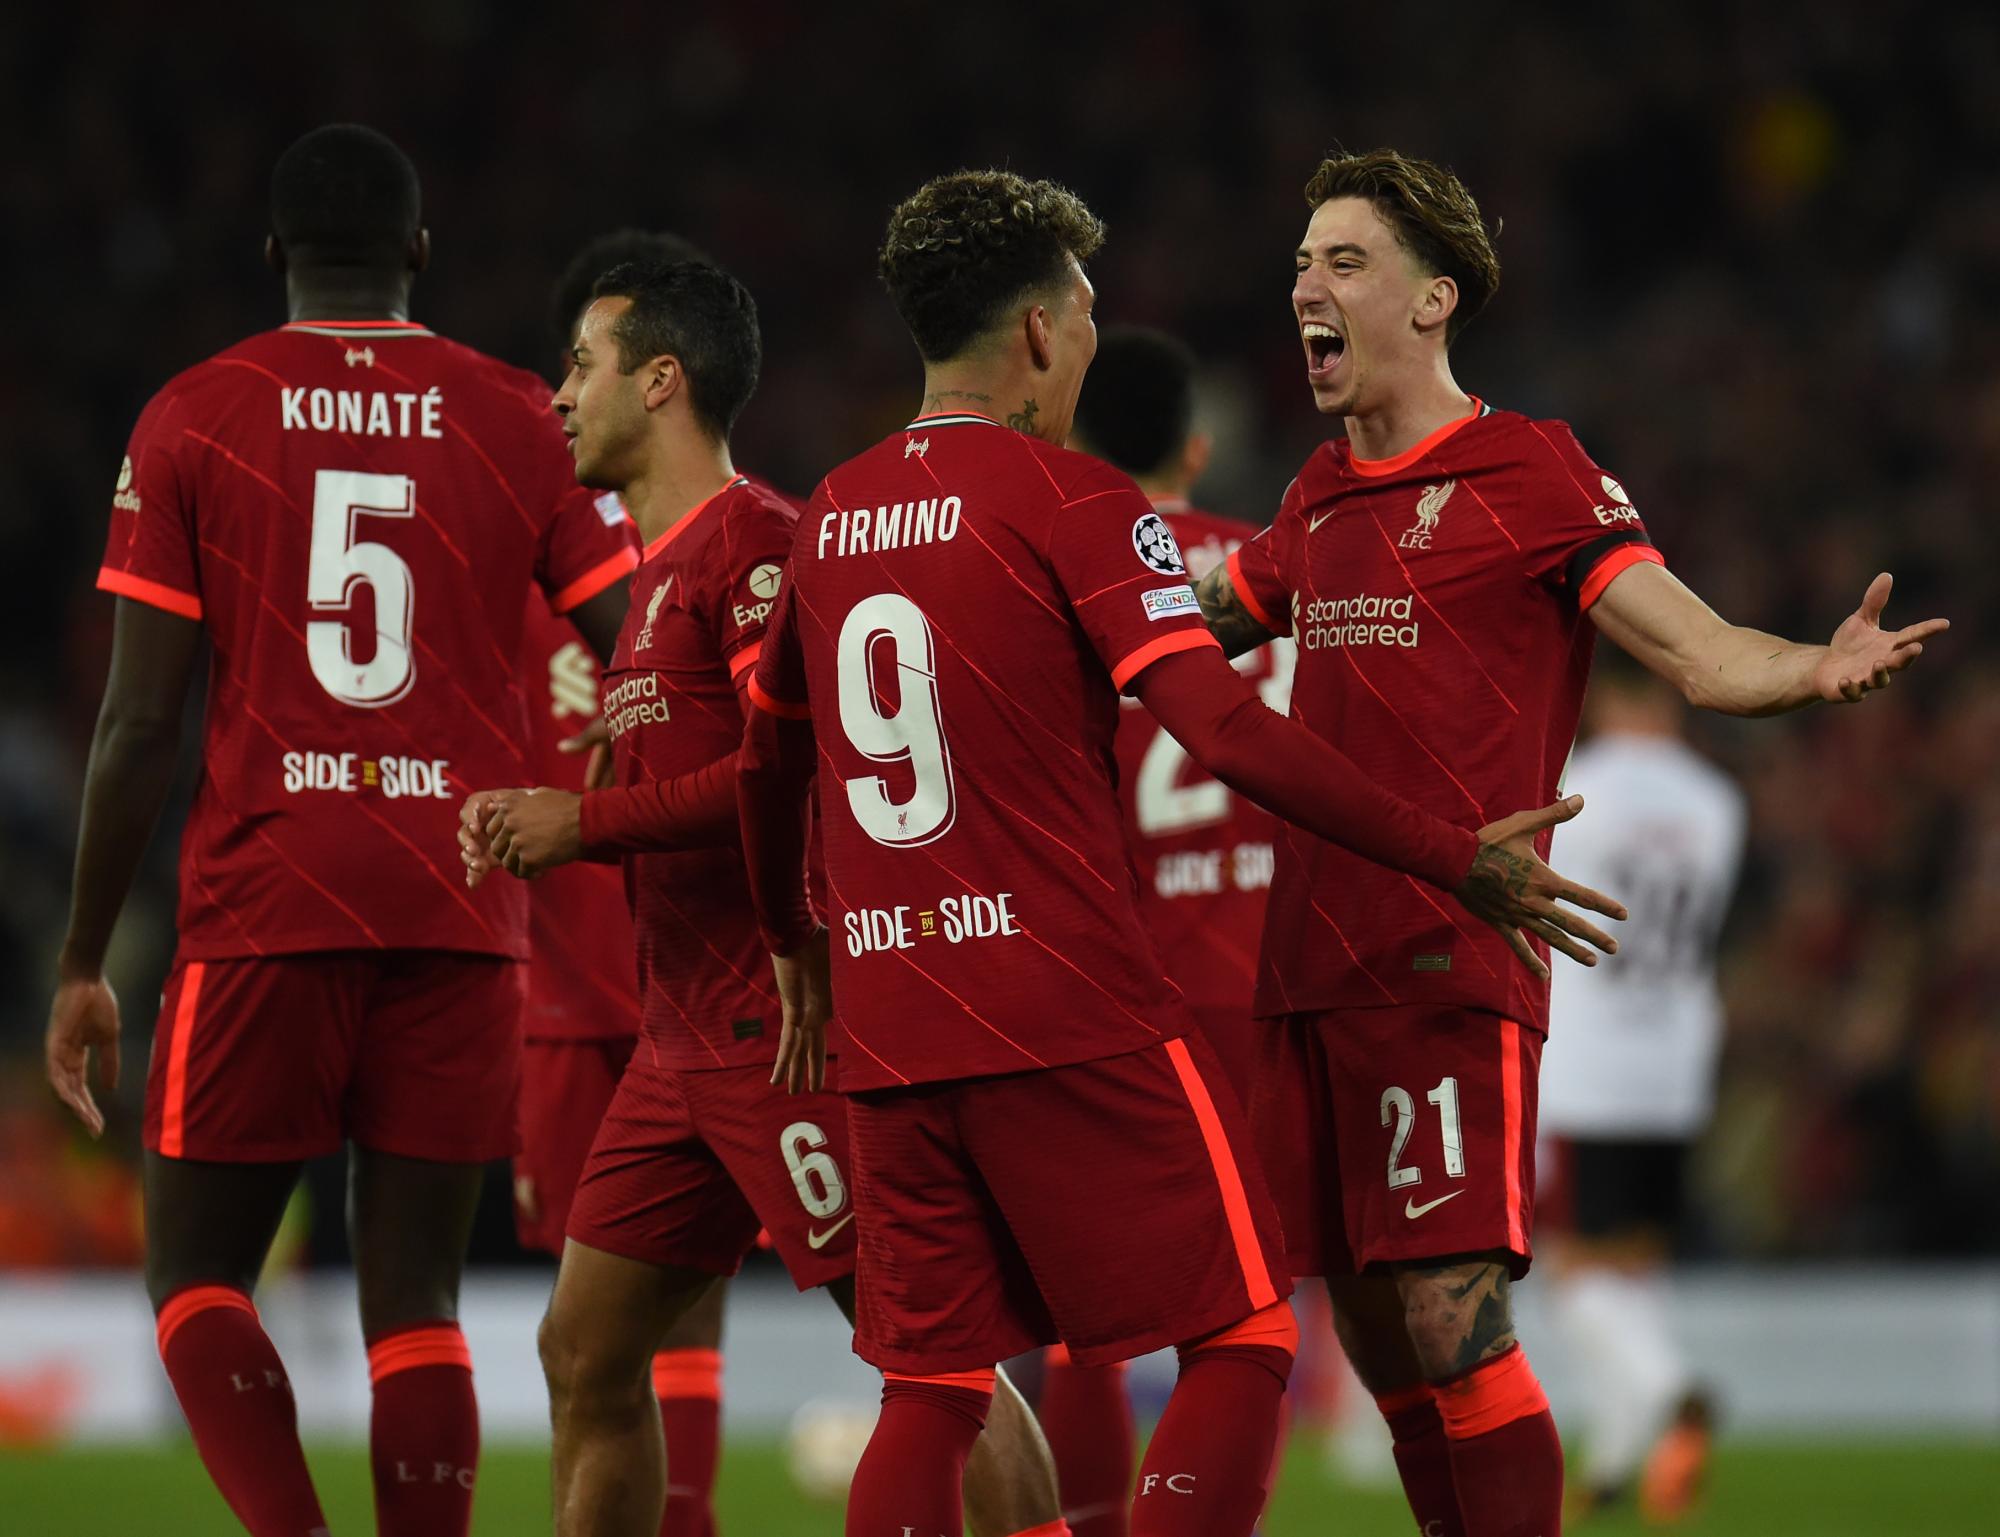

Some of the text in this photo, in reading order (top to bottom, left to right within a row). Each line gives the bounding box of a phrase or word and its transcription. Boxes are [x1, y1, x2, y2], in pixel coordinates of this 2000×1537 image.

[281, 386, 443, 438] KONATÉ
[818, 496, 962, 560] FIRMINO
[307, 470, 416, 709] 5
[1306, 593, 1413, 624] standard
[1305, 621, 1419, 650] chartered
[838, 593, 956, 849] 9
[282, 751, 358, 793] SIDE
[379, 756, 453, 799] SIDE
[844, 905, 916, 958] SIDE
[939, 893, 1021, 944] SIDE
[1381, 1076, 1466, 1191] 21
[779, 1121, 846, 1219] 6
